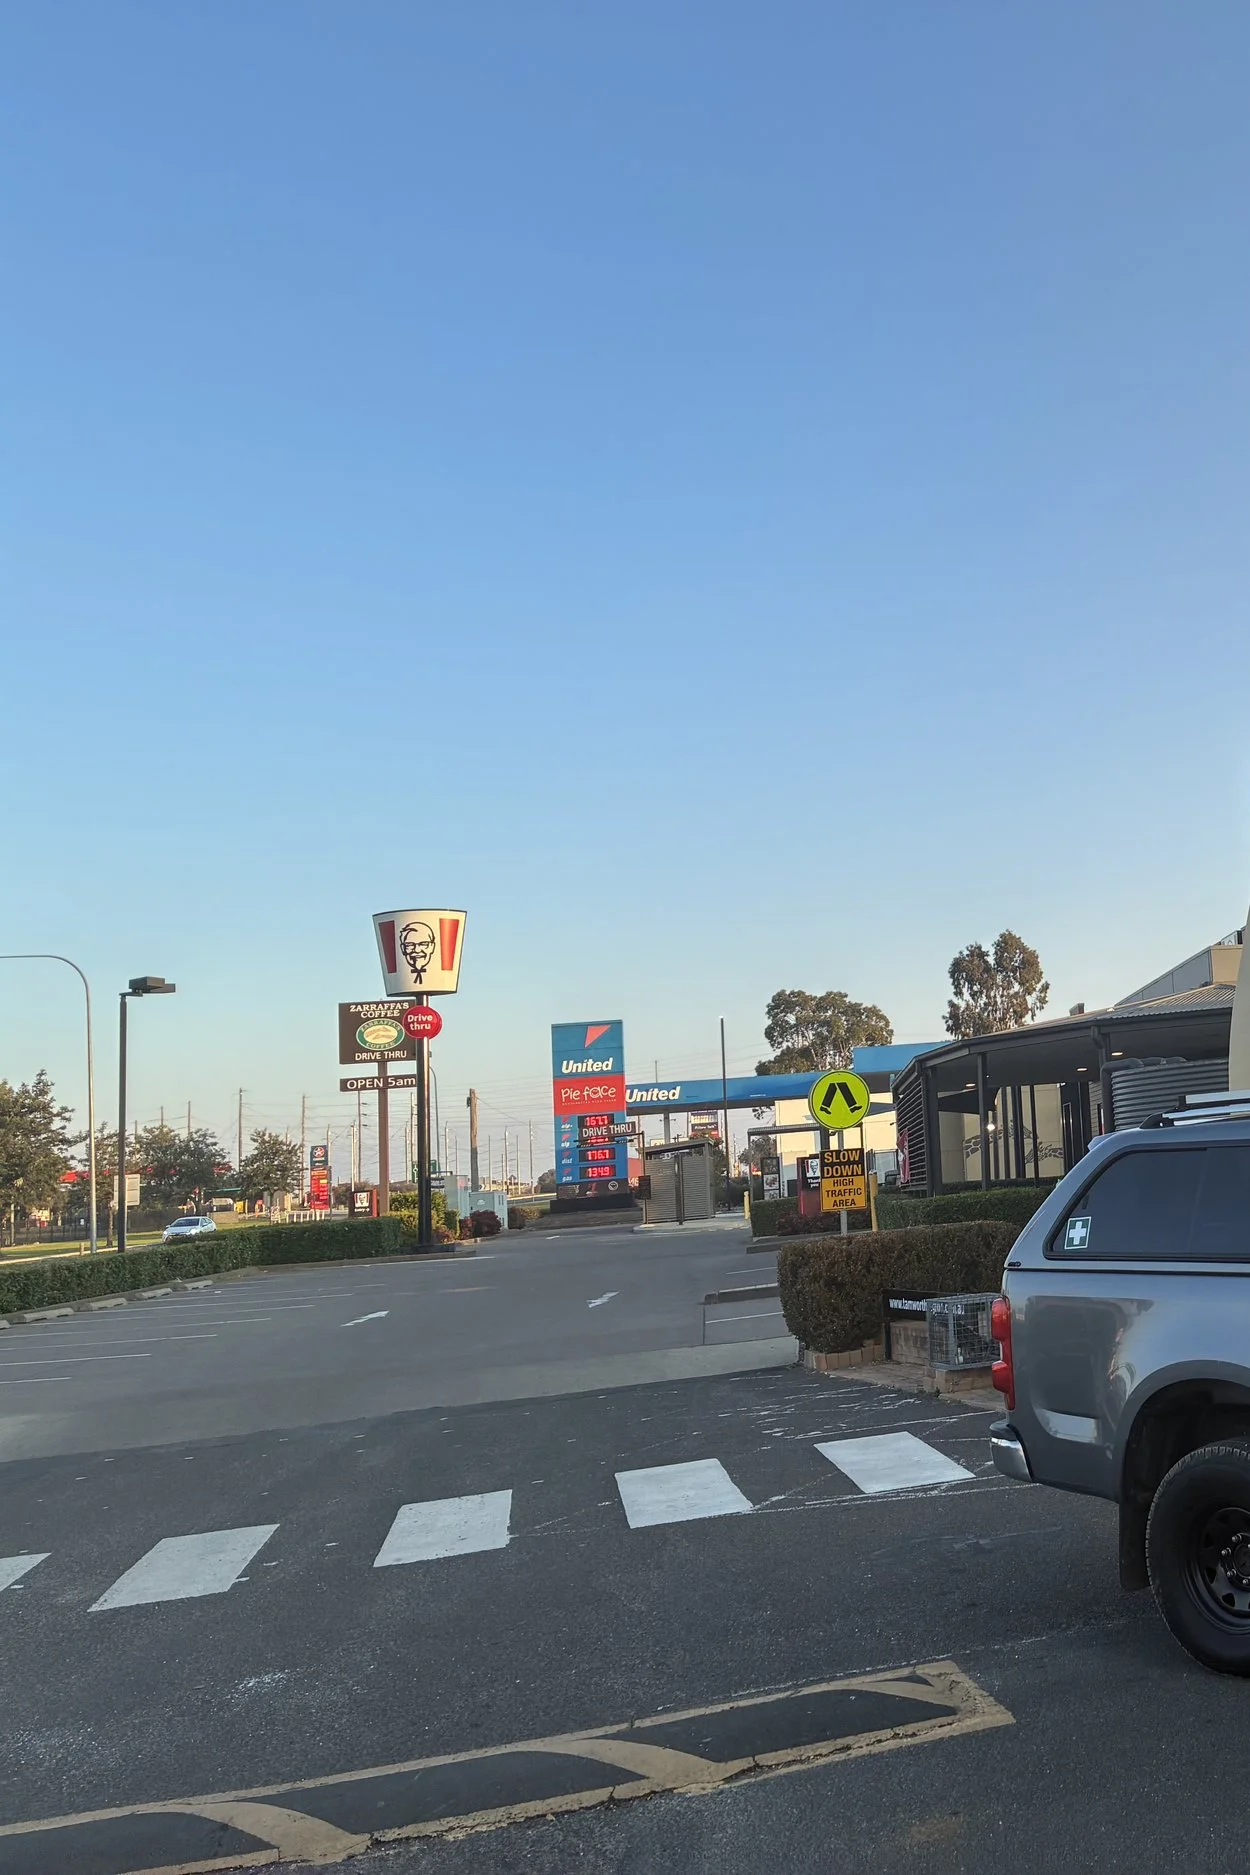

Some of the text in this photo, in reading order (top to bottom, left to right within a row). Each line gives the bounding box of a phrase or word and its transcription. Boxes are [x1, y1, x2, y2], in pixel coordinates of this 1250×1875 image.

[350, 1002, 409, 1012] ZARRAFFA'S
[361, 1010, 400, 1018] COFFEE
[408, 1014, 433, 1022] Drive
[361, 1020, 400, 1031] ZARRAFFA'S
[410, 1022, 431, 1030] thru
[366, 1041, 396, 1049] COFFEE
[355, 1050, 407, 1060] DRIVE THRU
[561, 1057, 613, 1074] United
[347, 1077, 416, 1089] OPEN 5am
[582, 1085, 617, 1101] face
[626, 1086, 681, 1103] United
[582, 1123, 632, 1138] DRIVE THRU
[824, 1150, 860, 1163] SLOW
[824, 1164, 862, 1177] DOWN
[833, 1178, 854, 1187] HIGH
[826, 1188, 862, 1198] TRAFFIC
[832, 1199, 856, 1208] AREA
